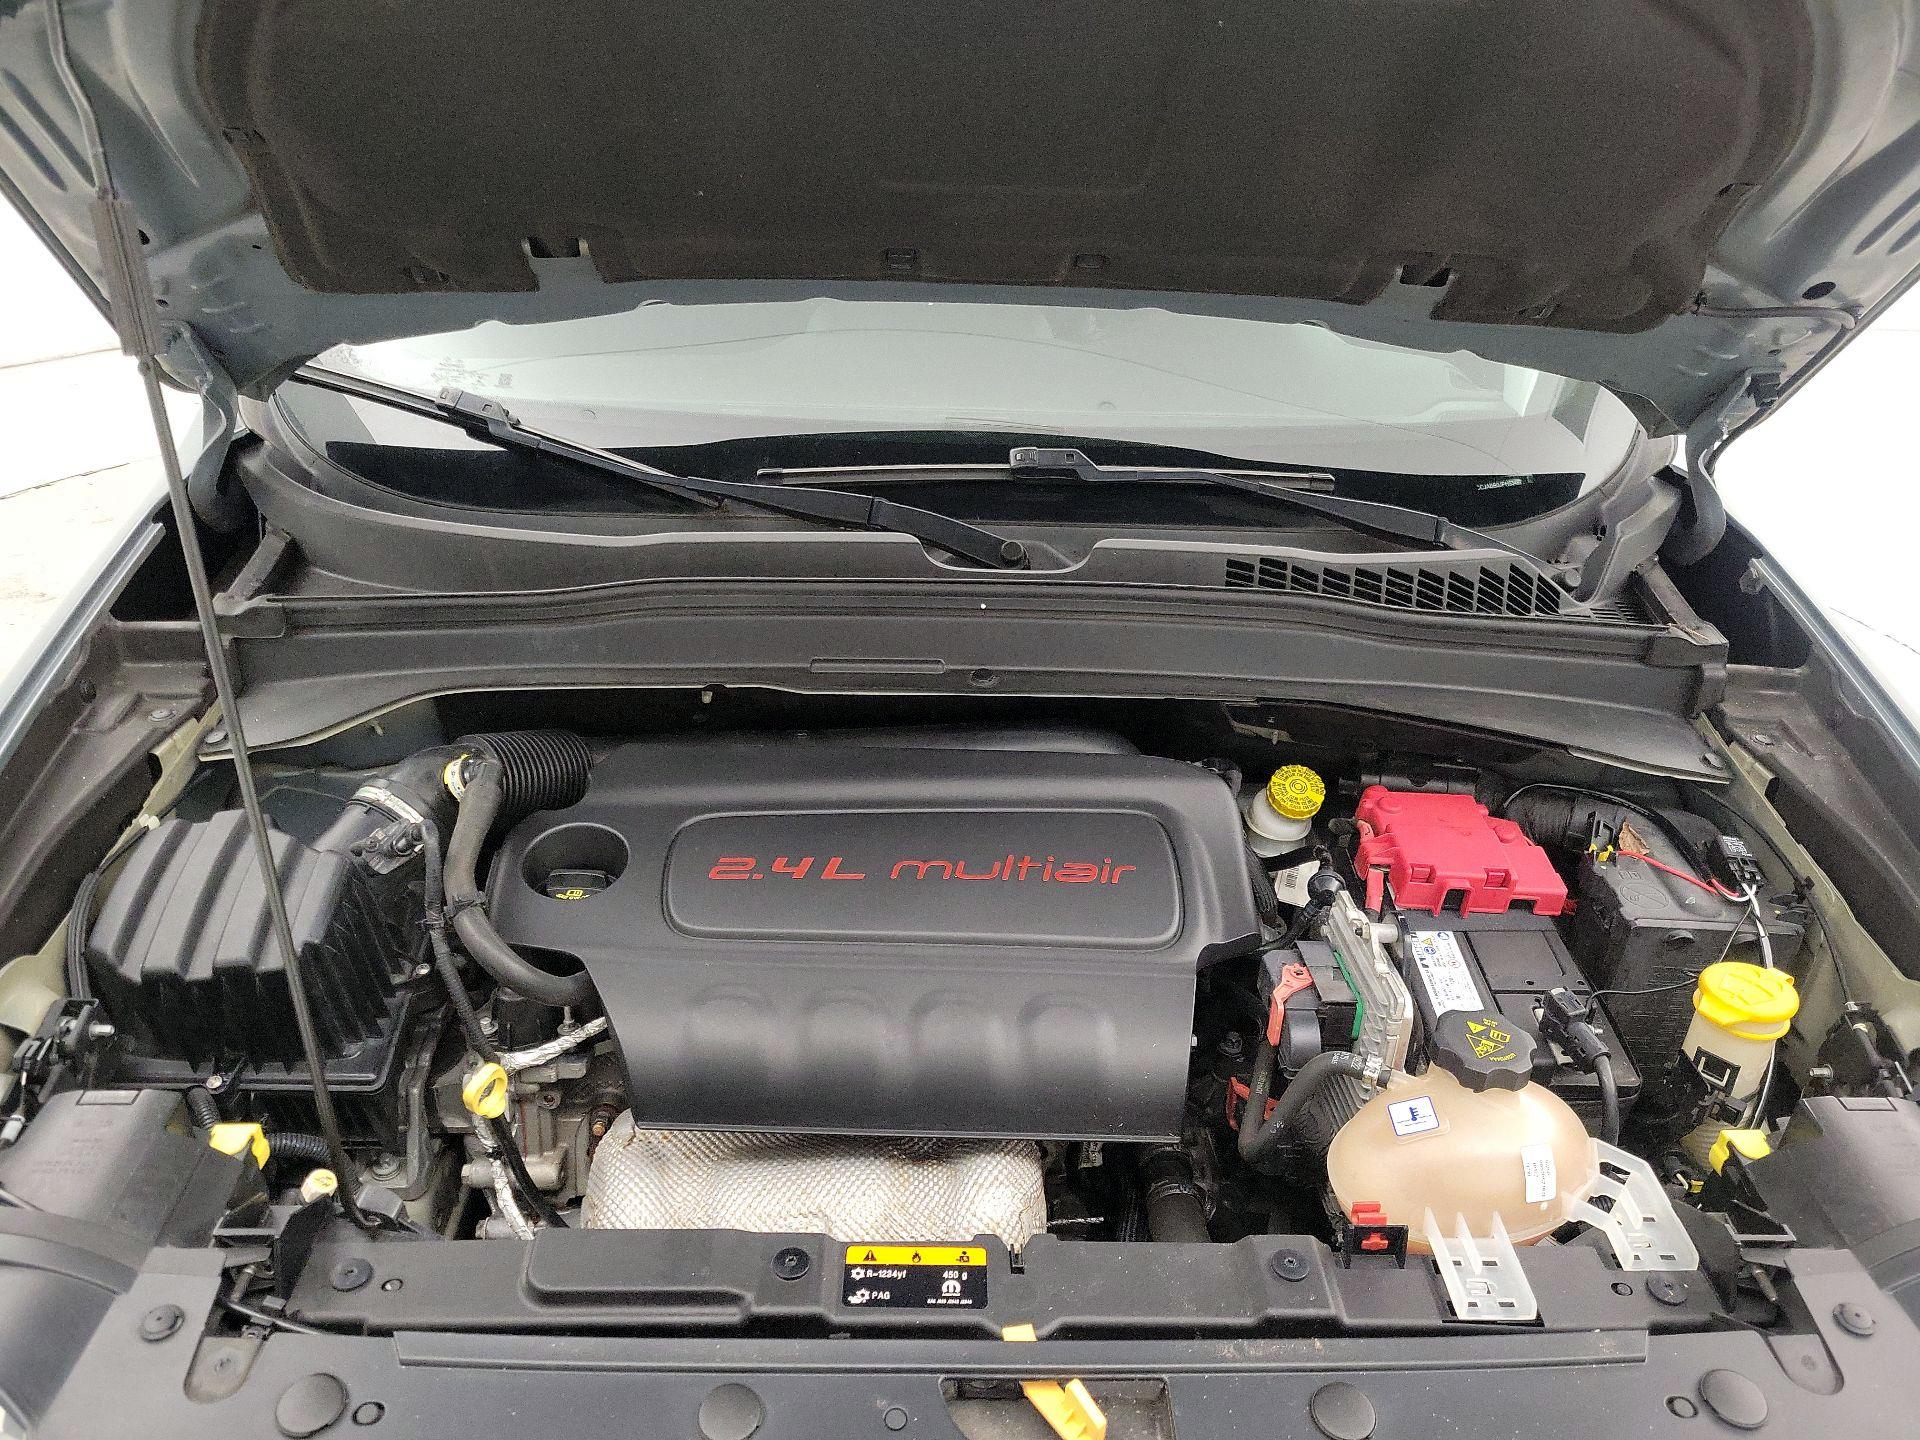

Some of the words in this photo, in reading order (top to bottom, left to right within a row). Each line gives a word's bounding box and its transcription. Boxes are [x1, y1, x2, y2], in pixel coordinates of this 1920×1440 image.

[890, 854, 1137, 885] multiair
[866, 1269, 907, 1280] R-1234yf
[942, 1270, 959, 1280] 450
[872, 1291, 890, 1300] PAG
